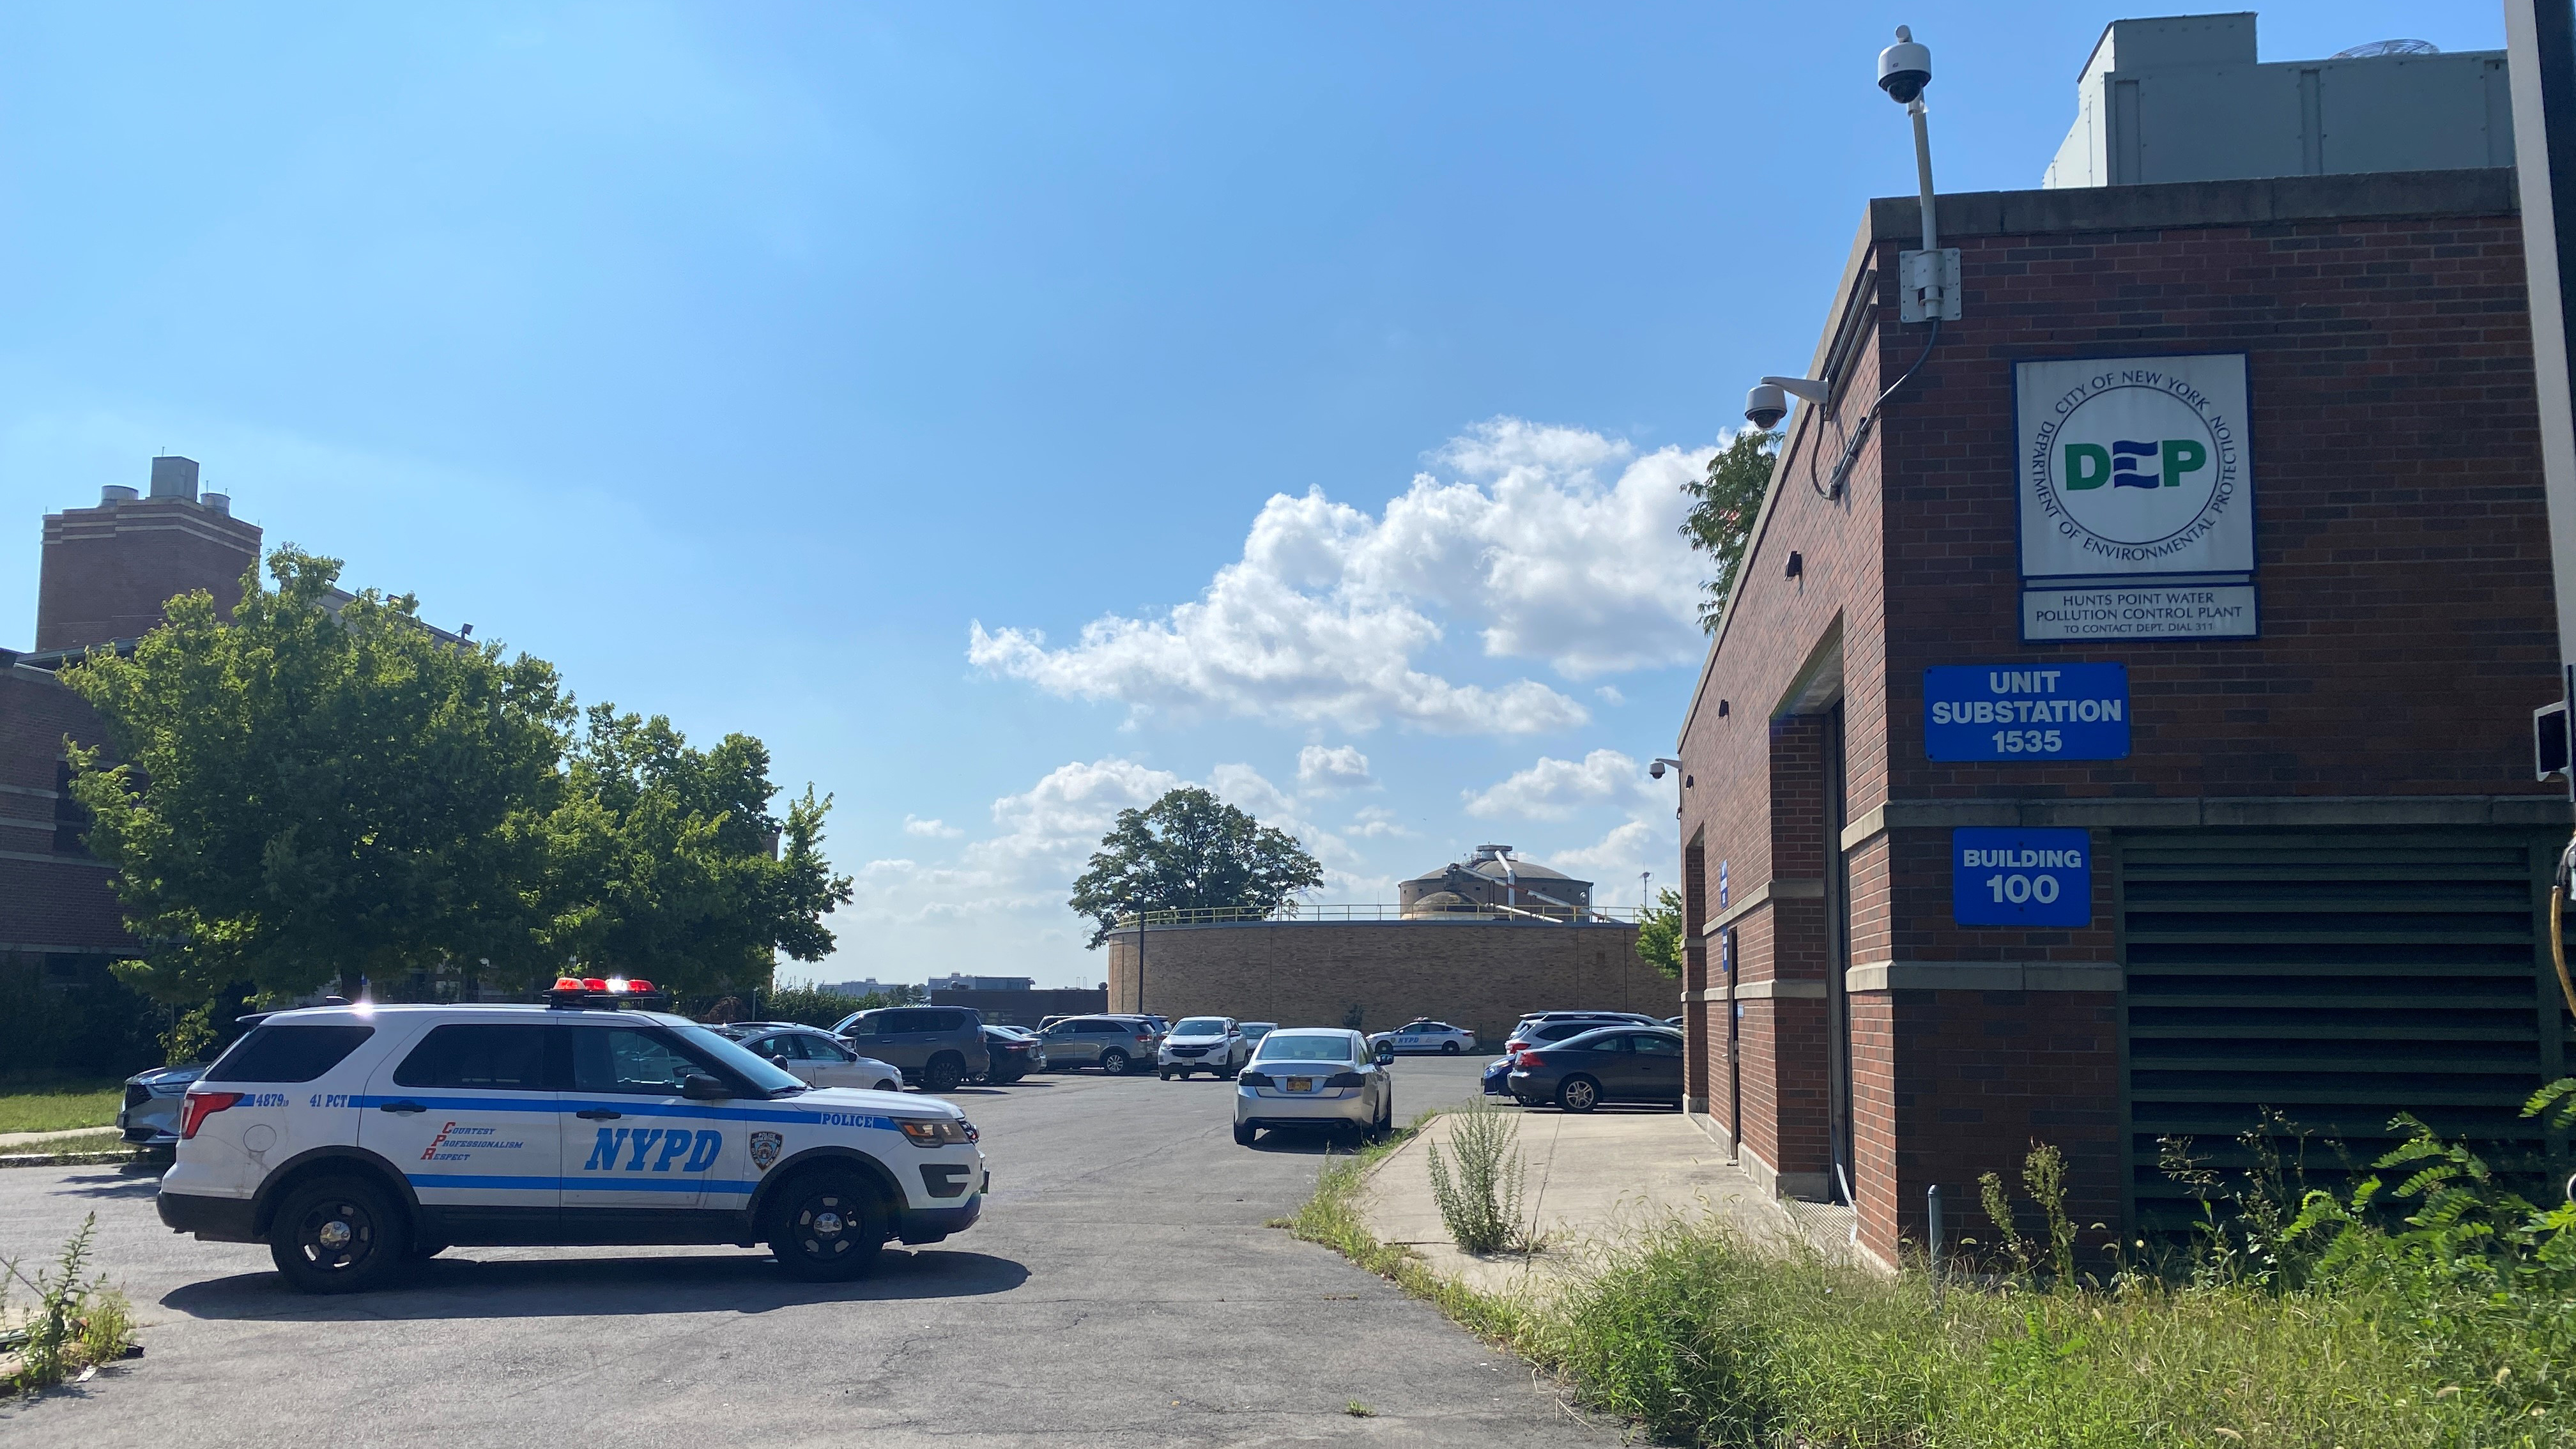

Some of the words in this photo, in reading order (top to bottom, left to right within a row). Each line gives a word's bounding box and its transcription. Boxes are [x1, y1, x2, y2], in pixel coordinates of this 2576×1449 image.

[2055, 384, 2086, 413] CITY
[2092, 372, 2114, 389] OF
[2122, 370, 2162, 384] NEW
[2168, 377, 2210, 411] YORK
[2065, 440, 2207, 491] DEP
[2032, 421, 2061, 518] DEPARTMENT
[2059, 521, 2081, 539] OF
[2083, 518, 2216, 560] ENVIRONMENTAL
[2210, 415, 2237, 514] PROTECTION
[2063, 594, 2112, 606] HUNTS
[2118, 593, 2161, 605] POINT
[2166, 592, 2215, 604] WATER
[2036, 609, 2117, 621] POLLUTION
[2123, 607, 2193, 619] CONTROL
[2198, 606, 2242, 618] PLANT
[2064, 625, 2079, 634] TO
[2083, 624, 2133, 633] CONTACT
[2137, 624, 2165, 632] DEPT.
[2168, 623, 2193, 631] DIAL
[1990, 671, 2060, 694] UNIT
[1933, 700, 2122, 724] SUBSTATION
[1992, 730, 2062, 753] 1535
[1963, 850, 2082, 868] BUILDING
[1986, 874, 2060, 903] 100
[256, 1094, 284, 1107] 4879
[310, 1094, 322, 1107] 41
[325, 1094, 348, 1108] PCT
[822, 1113, 873, 1128] POLICE
[584, 1128, 723, 1172] NYPD
